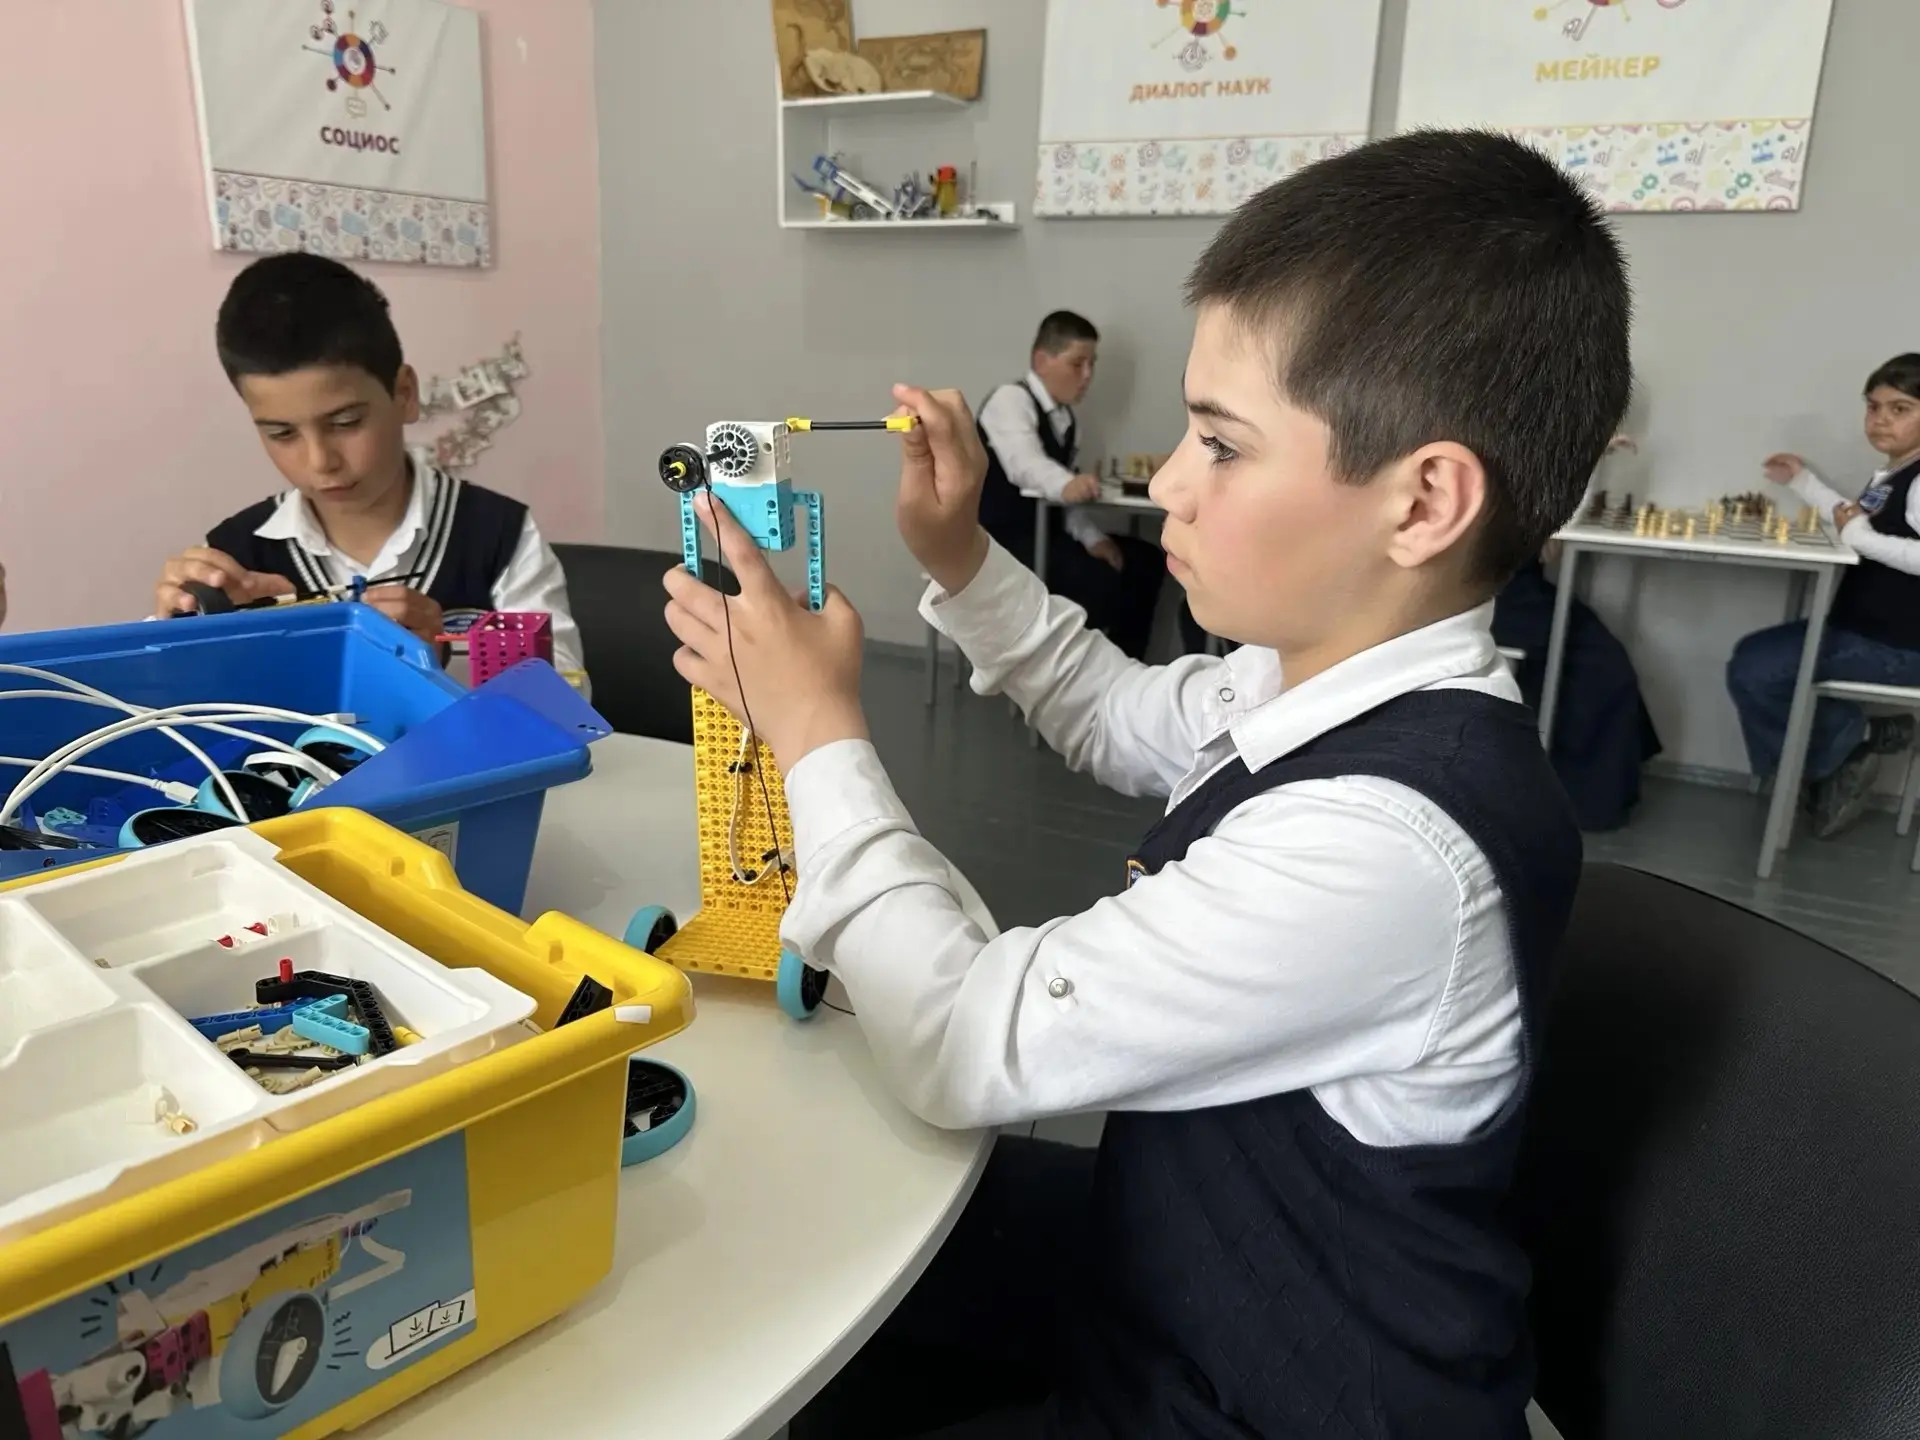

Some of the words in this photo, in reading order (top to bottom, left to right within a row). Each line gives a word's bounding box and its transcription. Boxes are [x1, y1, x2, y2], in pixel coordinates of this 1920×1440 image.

[1535, 52, 1660, 83] МЕЙКЕР
[1129, 80, 1212, 103] ДИАЛОГ
[1217, 77, 1272, 97] НАУК
[320, 126, 400, 155] СОЦИОС
